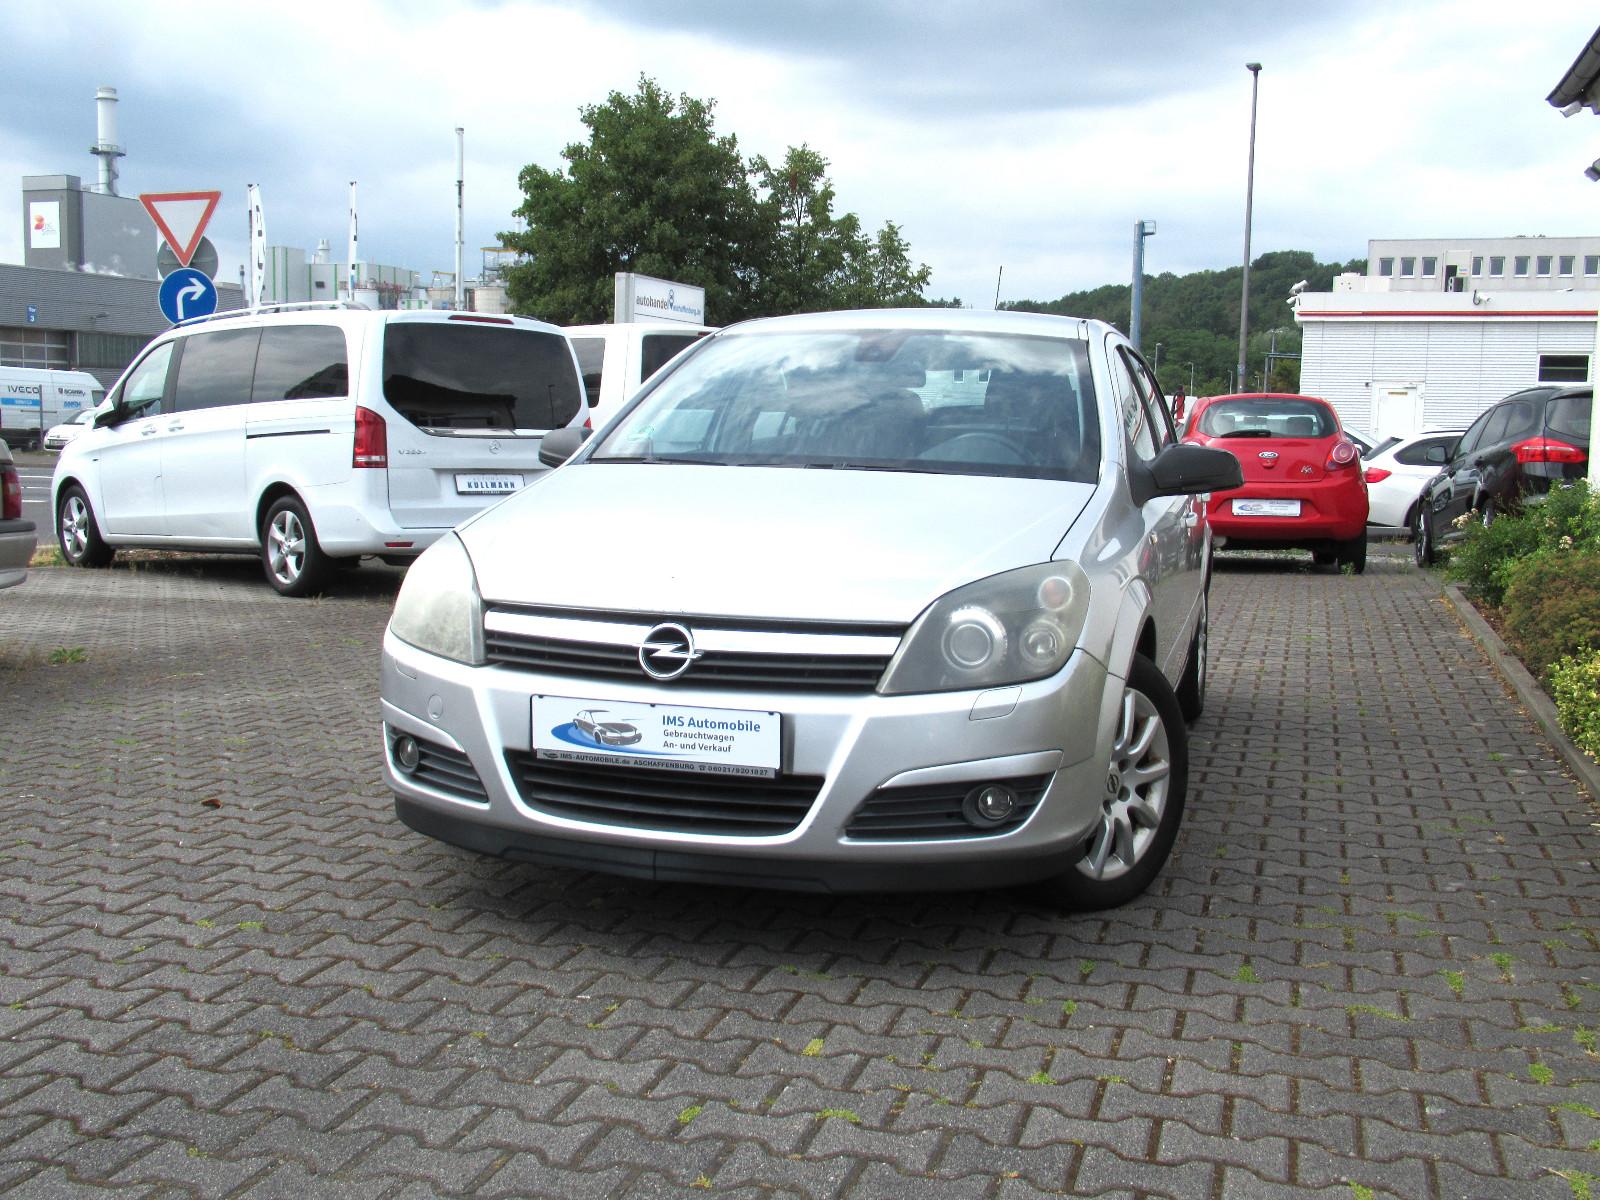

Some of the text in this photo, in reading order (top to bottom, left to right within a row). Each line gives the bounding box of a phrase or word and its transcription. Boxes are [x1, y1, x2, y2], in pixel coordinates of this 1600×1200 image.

[7, 385, 40, 394] IVECO
[662, 714, 761, 732] IMS Automobile
[663, 729, 735, 743] Gebrauchtwagen
[662, 740, 732, 753] An- und Verkauf
[633, 760, 695, 770] ASCHAFFENBURG
